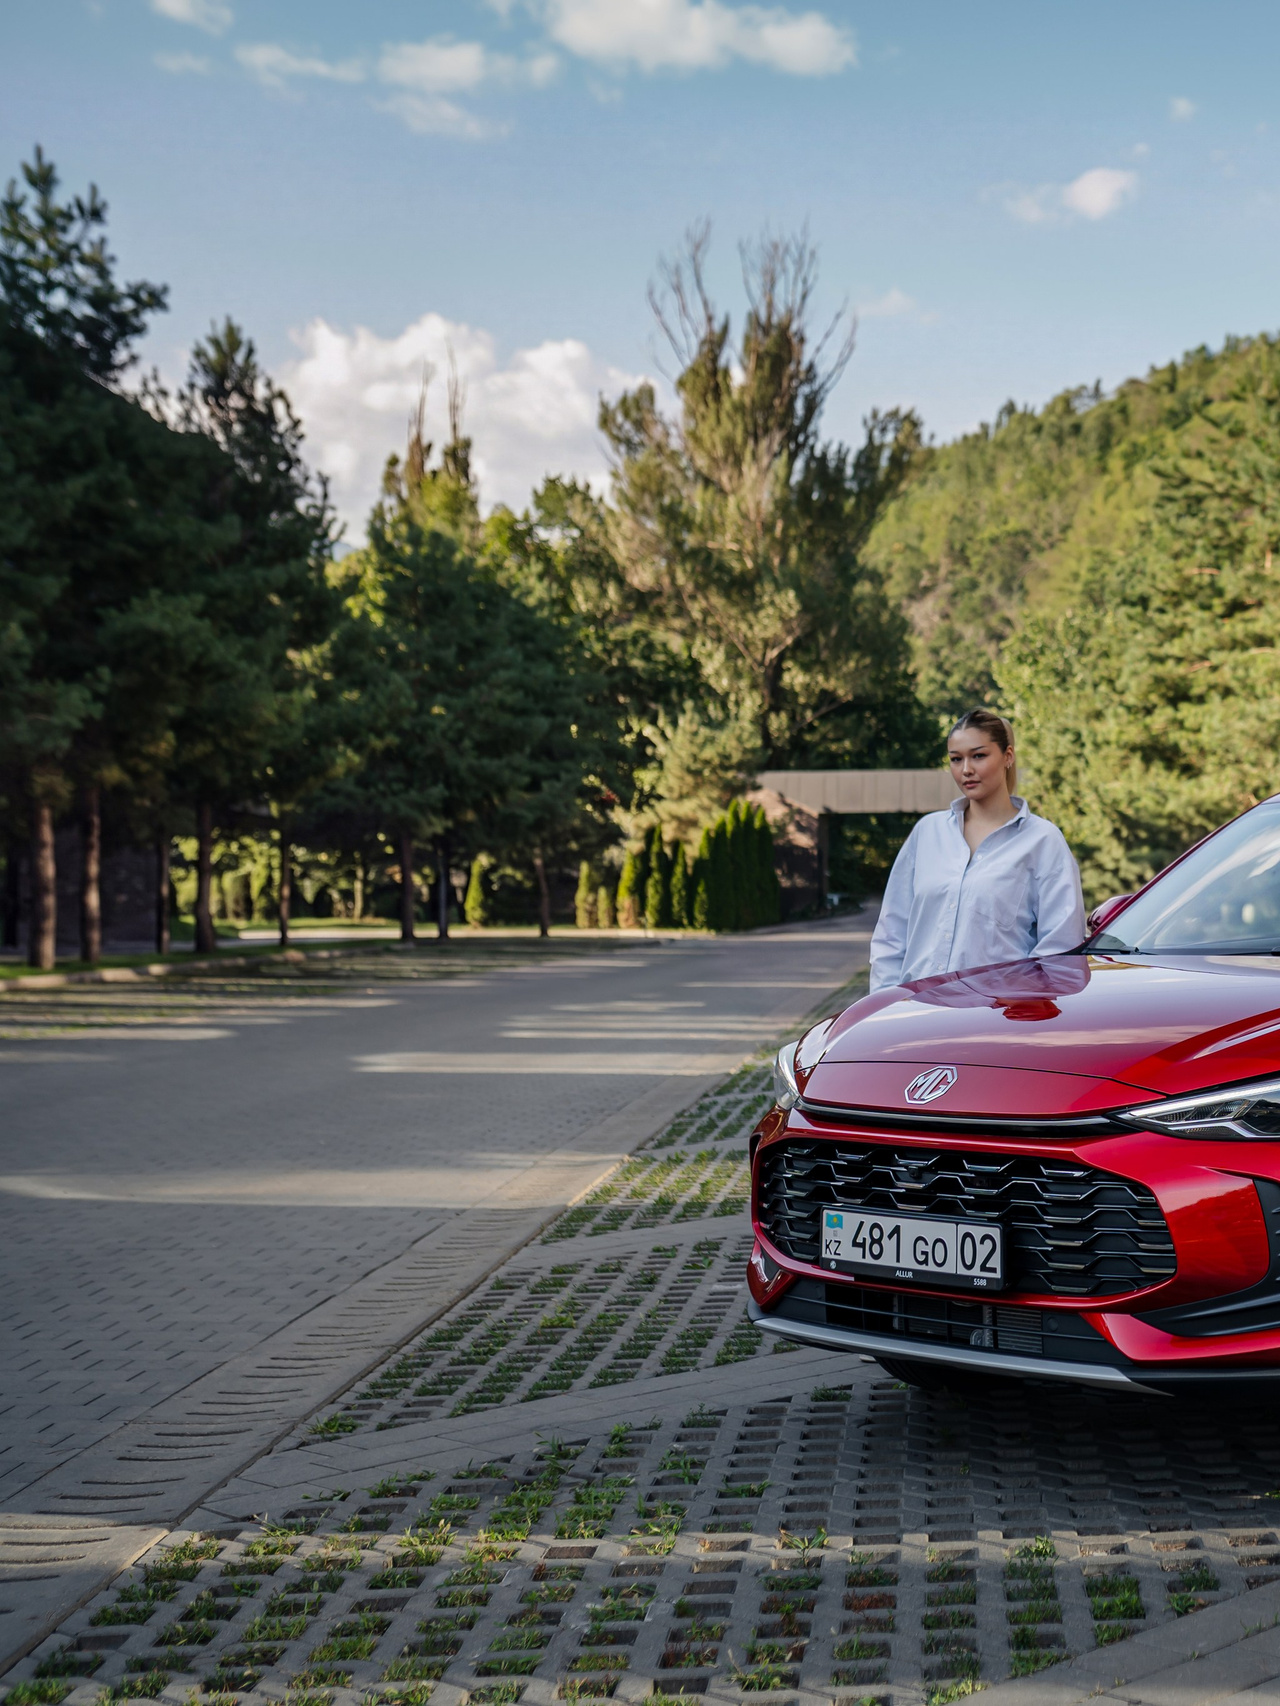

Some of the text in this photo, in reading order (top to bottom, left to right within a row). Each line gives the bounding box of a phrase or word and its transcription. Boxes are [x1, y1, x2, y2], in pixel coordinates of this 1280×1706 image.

[909, 1069, 953, 1100] MG
[825, 1238, 842, 1256] KZ
[851, 1220, 998, 1274] 481 GO 02
[895, 1269, 914, 1279] ALLUR
[973, 1278, 987, 1287] 5588
